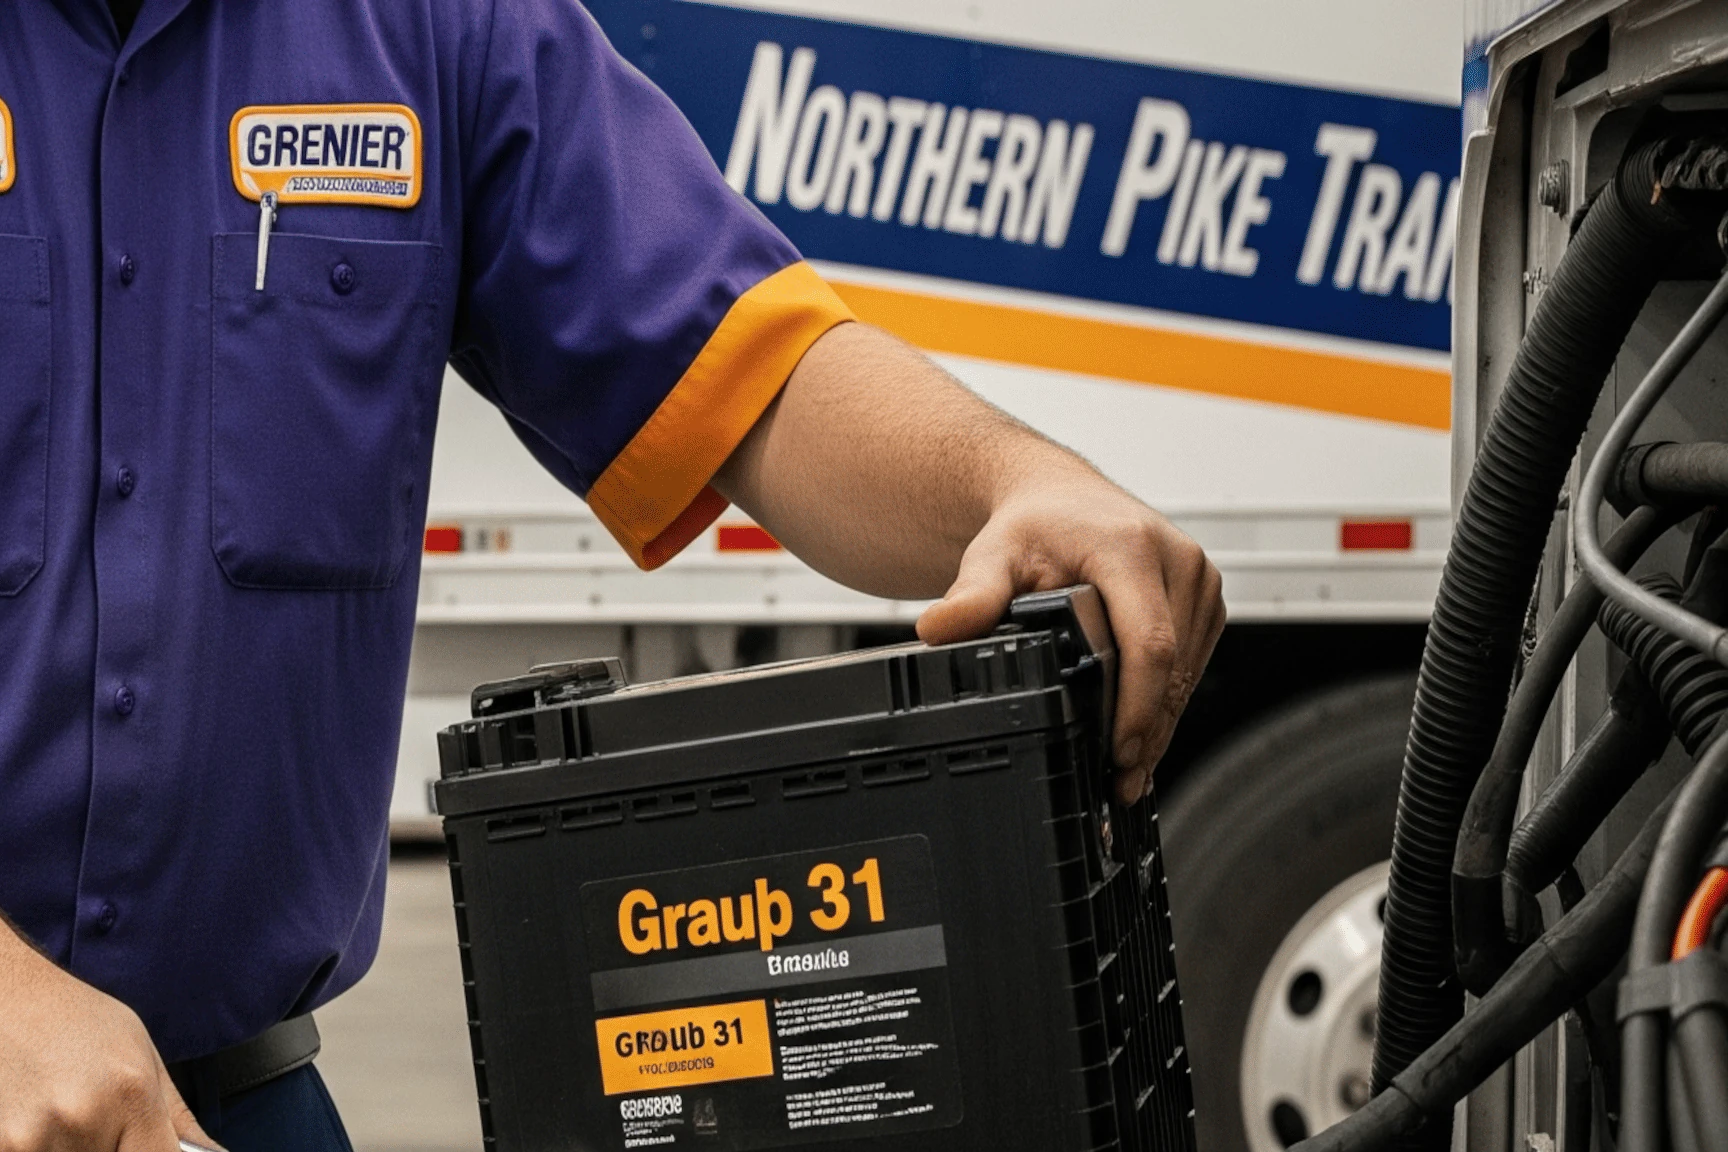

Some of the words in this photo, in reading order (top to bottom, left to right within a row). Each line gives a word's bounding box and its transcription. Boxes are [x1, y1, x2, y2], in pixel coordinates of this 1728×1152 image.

[247, 124, 405, 170] GRENIER
[1100, 96, 1286, 277] PIKE
[807, 858, 885, 931] 31
[713, 1017, 743, 1047] 31
